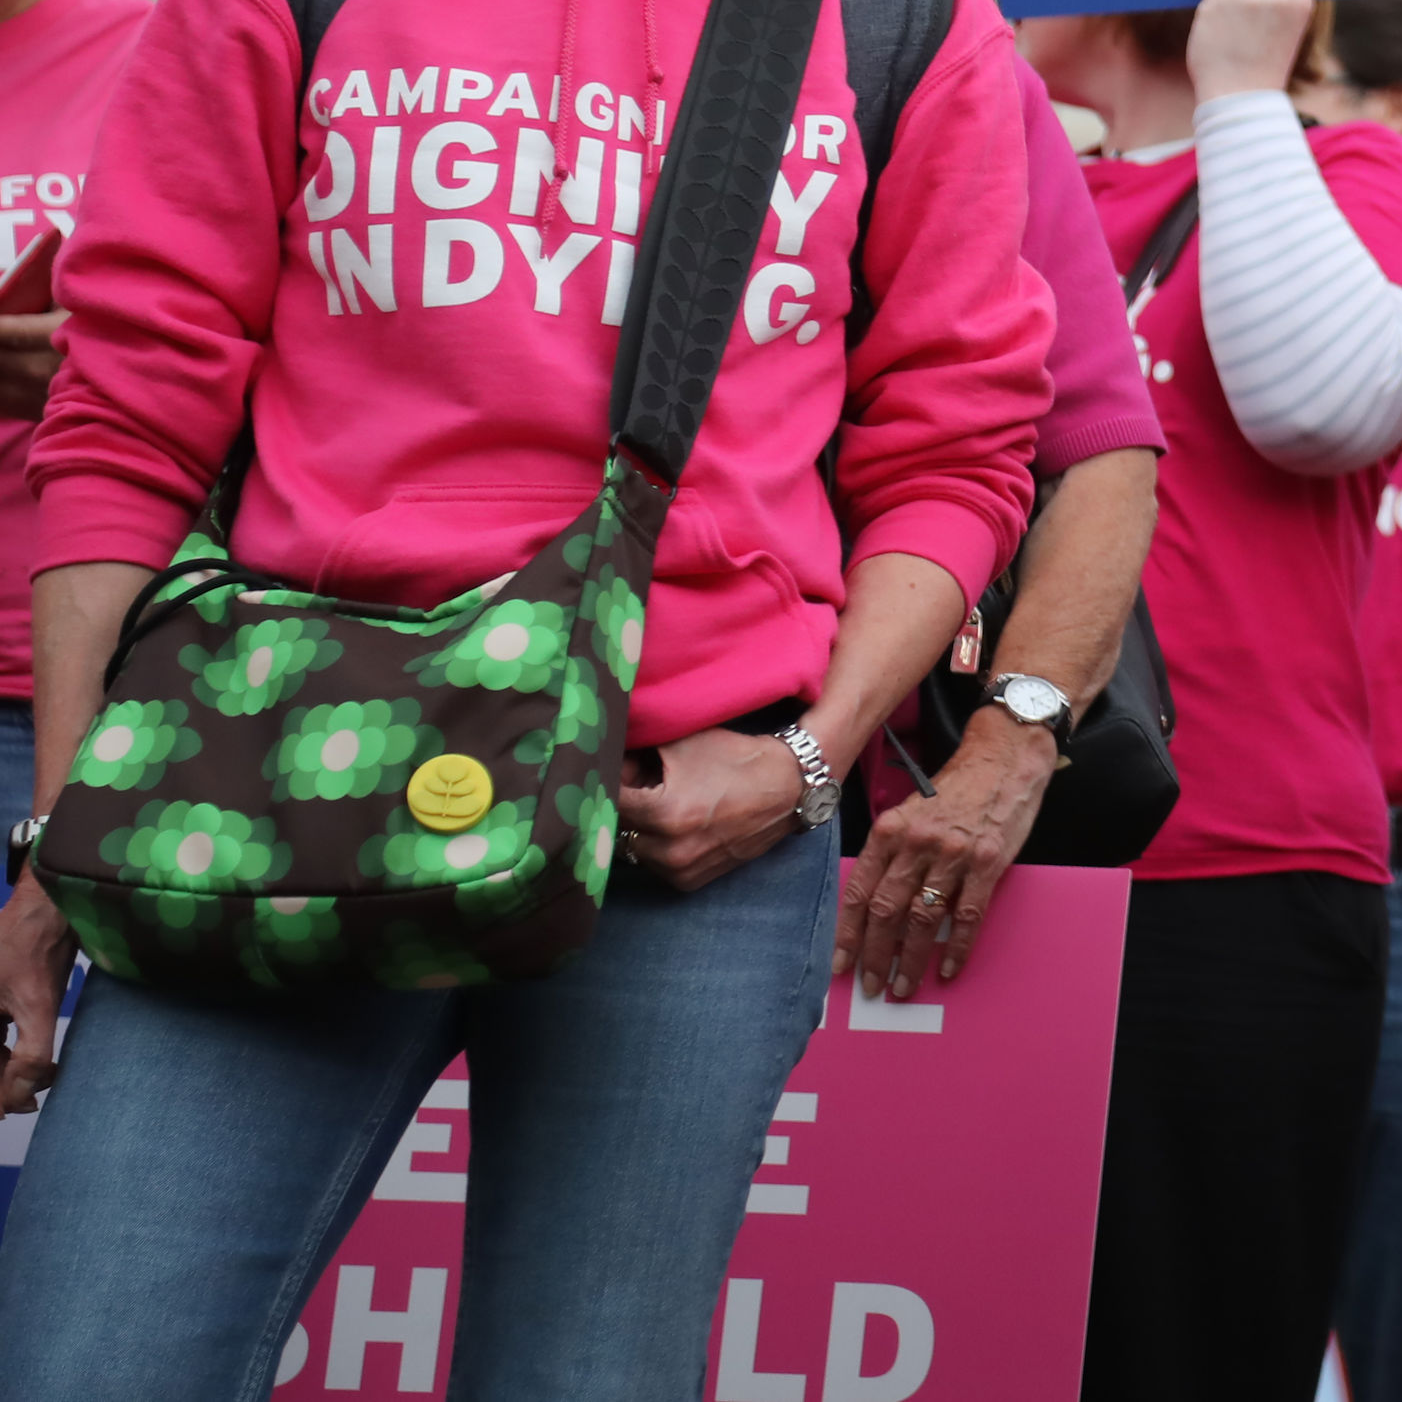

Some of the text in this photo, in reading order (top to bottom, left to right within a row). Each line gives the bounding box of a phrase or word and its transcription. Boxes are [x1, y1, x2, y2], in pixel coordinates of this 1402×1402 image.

[0, 171, 87, 209] FO
[303, 119, 839, 257] DIGNIY
[307, 218, 822, 345] IN DYIG.
